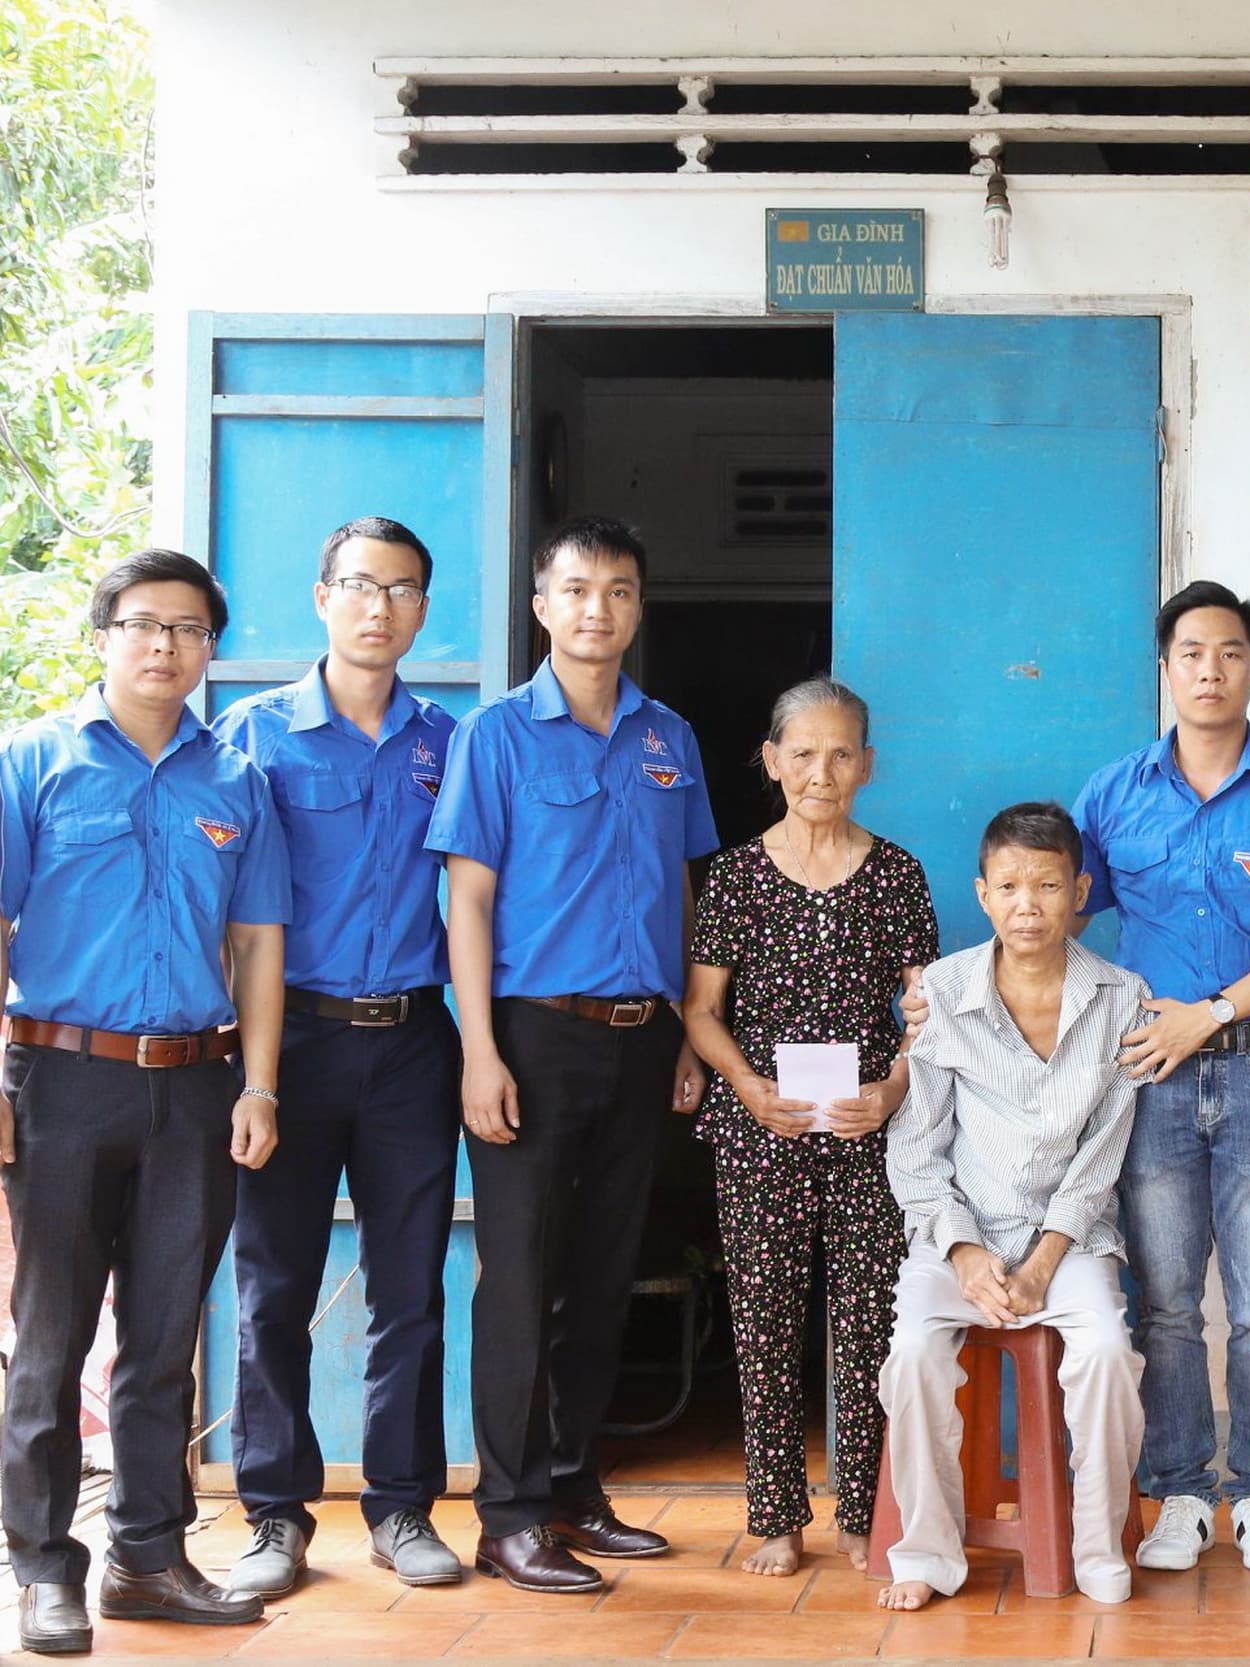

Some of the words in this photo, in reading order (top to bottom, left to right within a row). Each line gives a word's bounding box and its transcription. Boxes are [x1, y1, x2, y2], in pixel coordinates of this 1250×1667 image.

[817, 224, 851, 242] GIA
[856, 219, 905, 242] ĐÌNH
[776, 264, 805, 302] ĐẠT
[807, 246, 852, 295] CHUẨN
[856, 256, 882, 294] VĂN
[885, 256, 914, 295] HÓA
